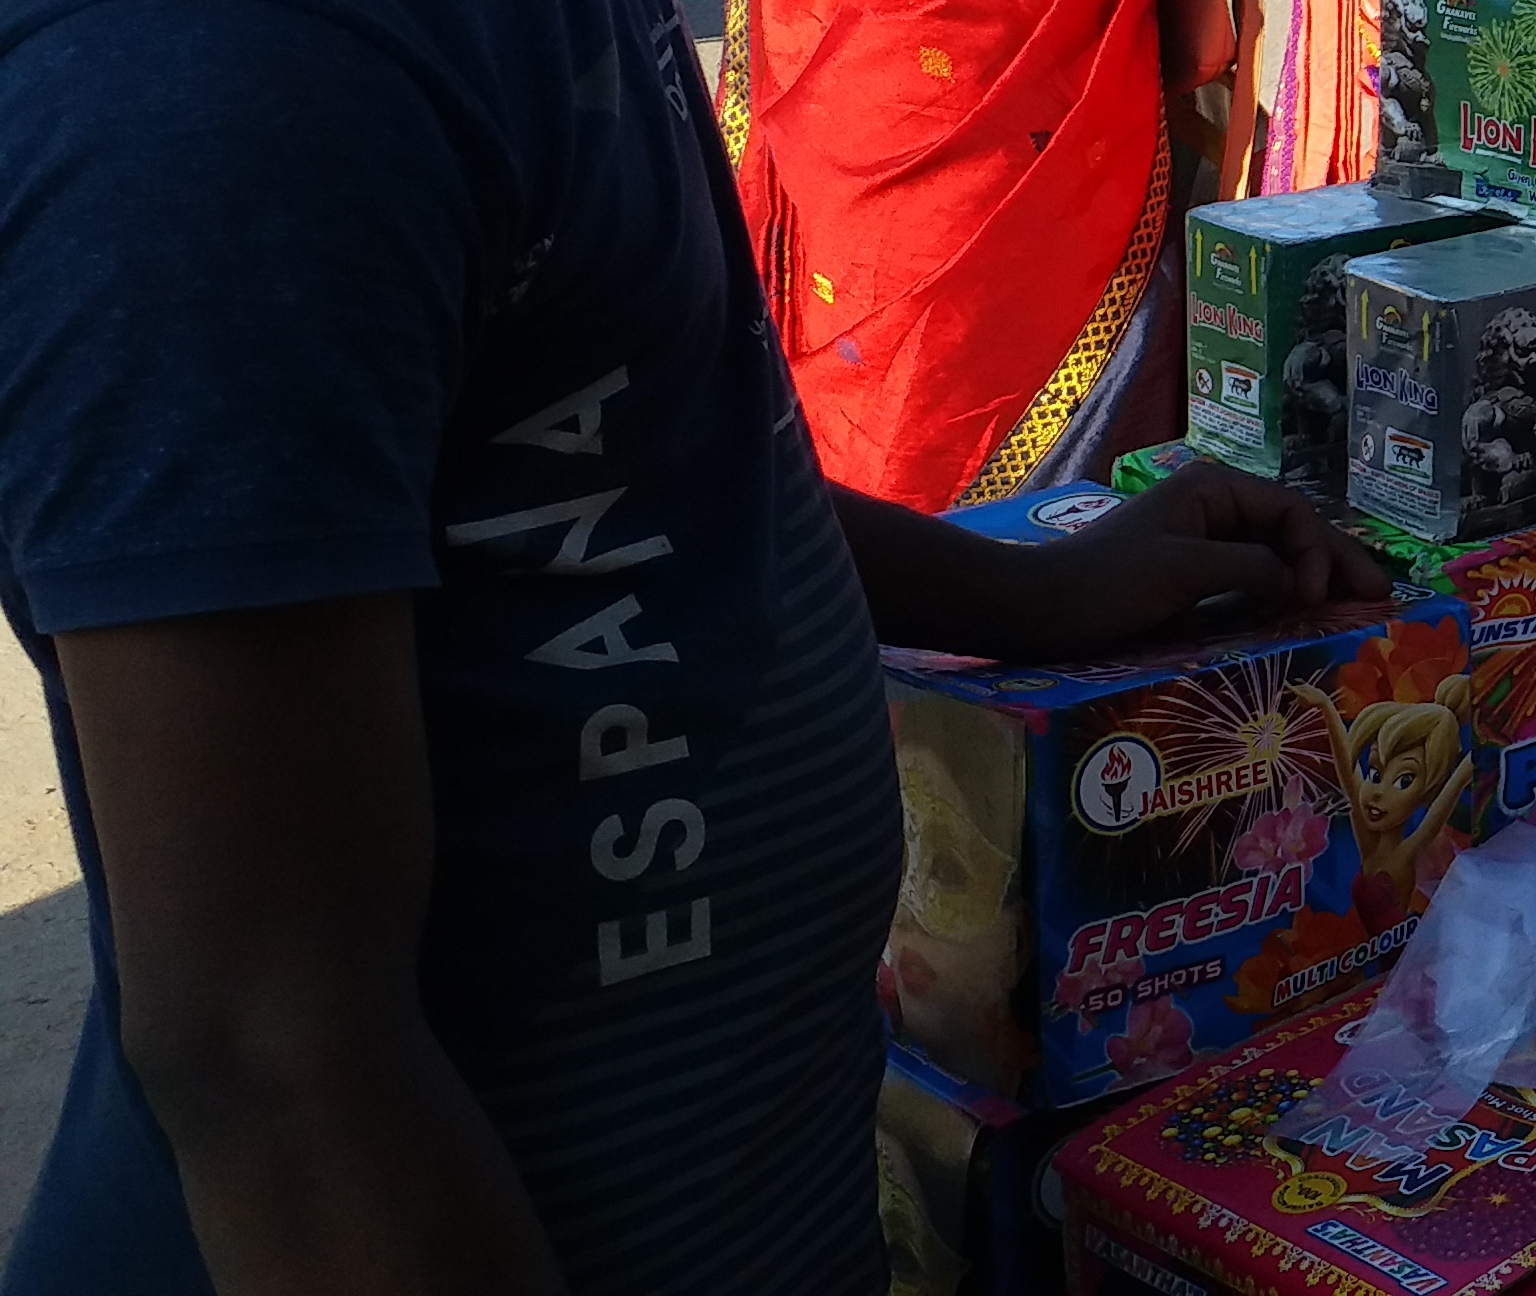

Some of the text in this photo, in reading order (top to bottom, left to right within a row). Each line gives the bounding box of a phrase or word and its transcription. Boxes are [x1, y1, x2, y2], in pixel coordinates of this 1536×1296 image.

[1460, 100, 1523, 155] LION
[1190, 291, 1265, 341] LION KING
[1355, 354, 1439, 412] LION KING
[1137, 759, 1270, 820] JAISHREE
[1066, 866, 1303, 977] FREESIA
[1087, 960, 1224, 1013] 50 SHOTS
[1271, 915, 1419, 1009] MULTI COLOUR
[1298, 1114, 1453, 1195] MAN
[1311, 1221, 1441, 1295] VASANTHA'S
